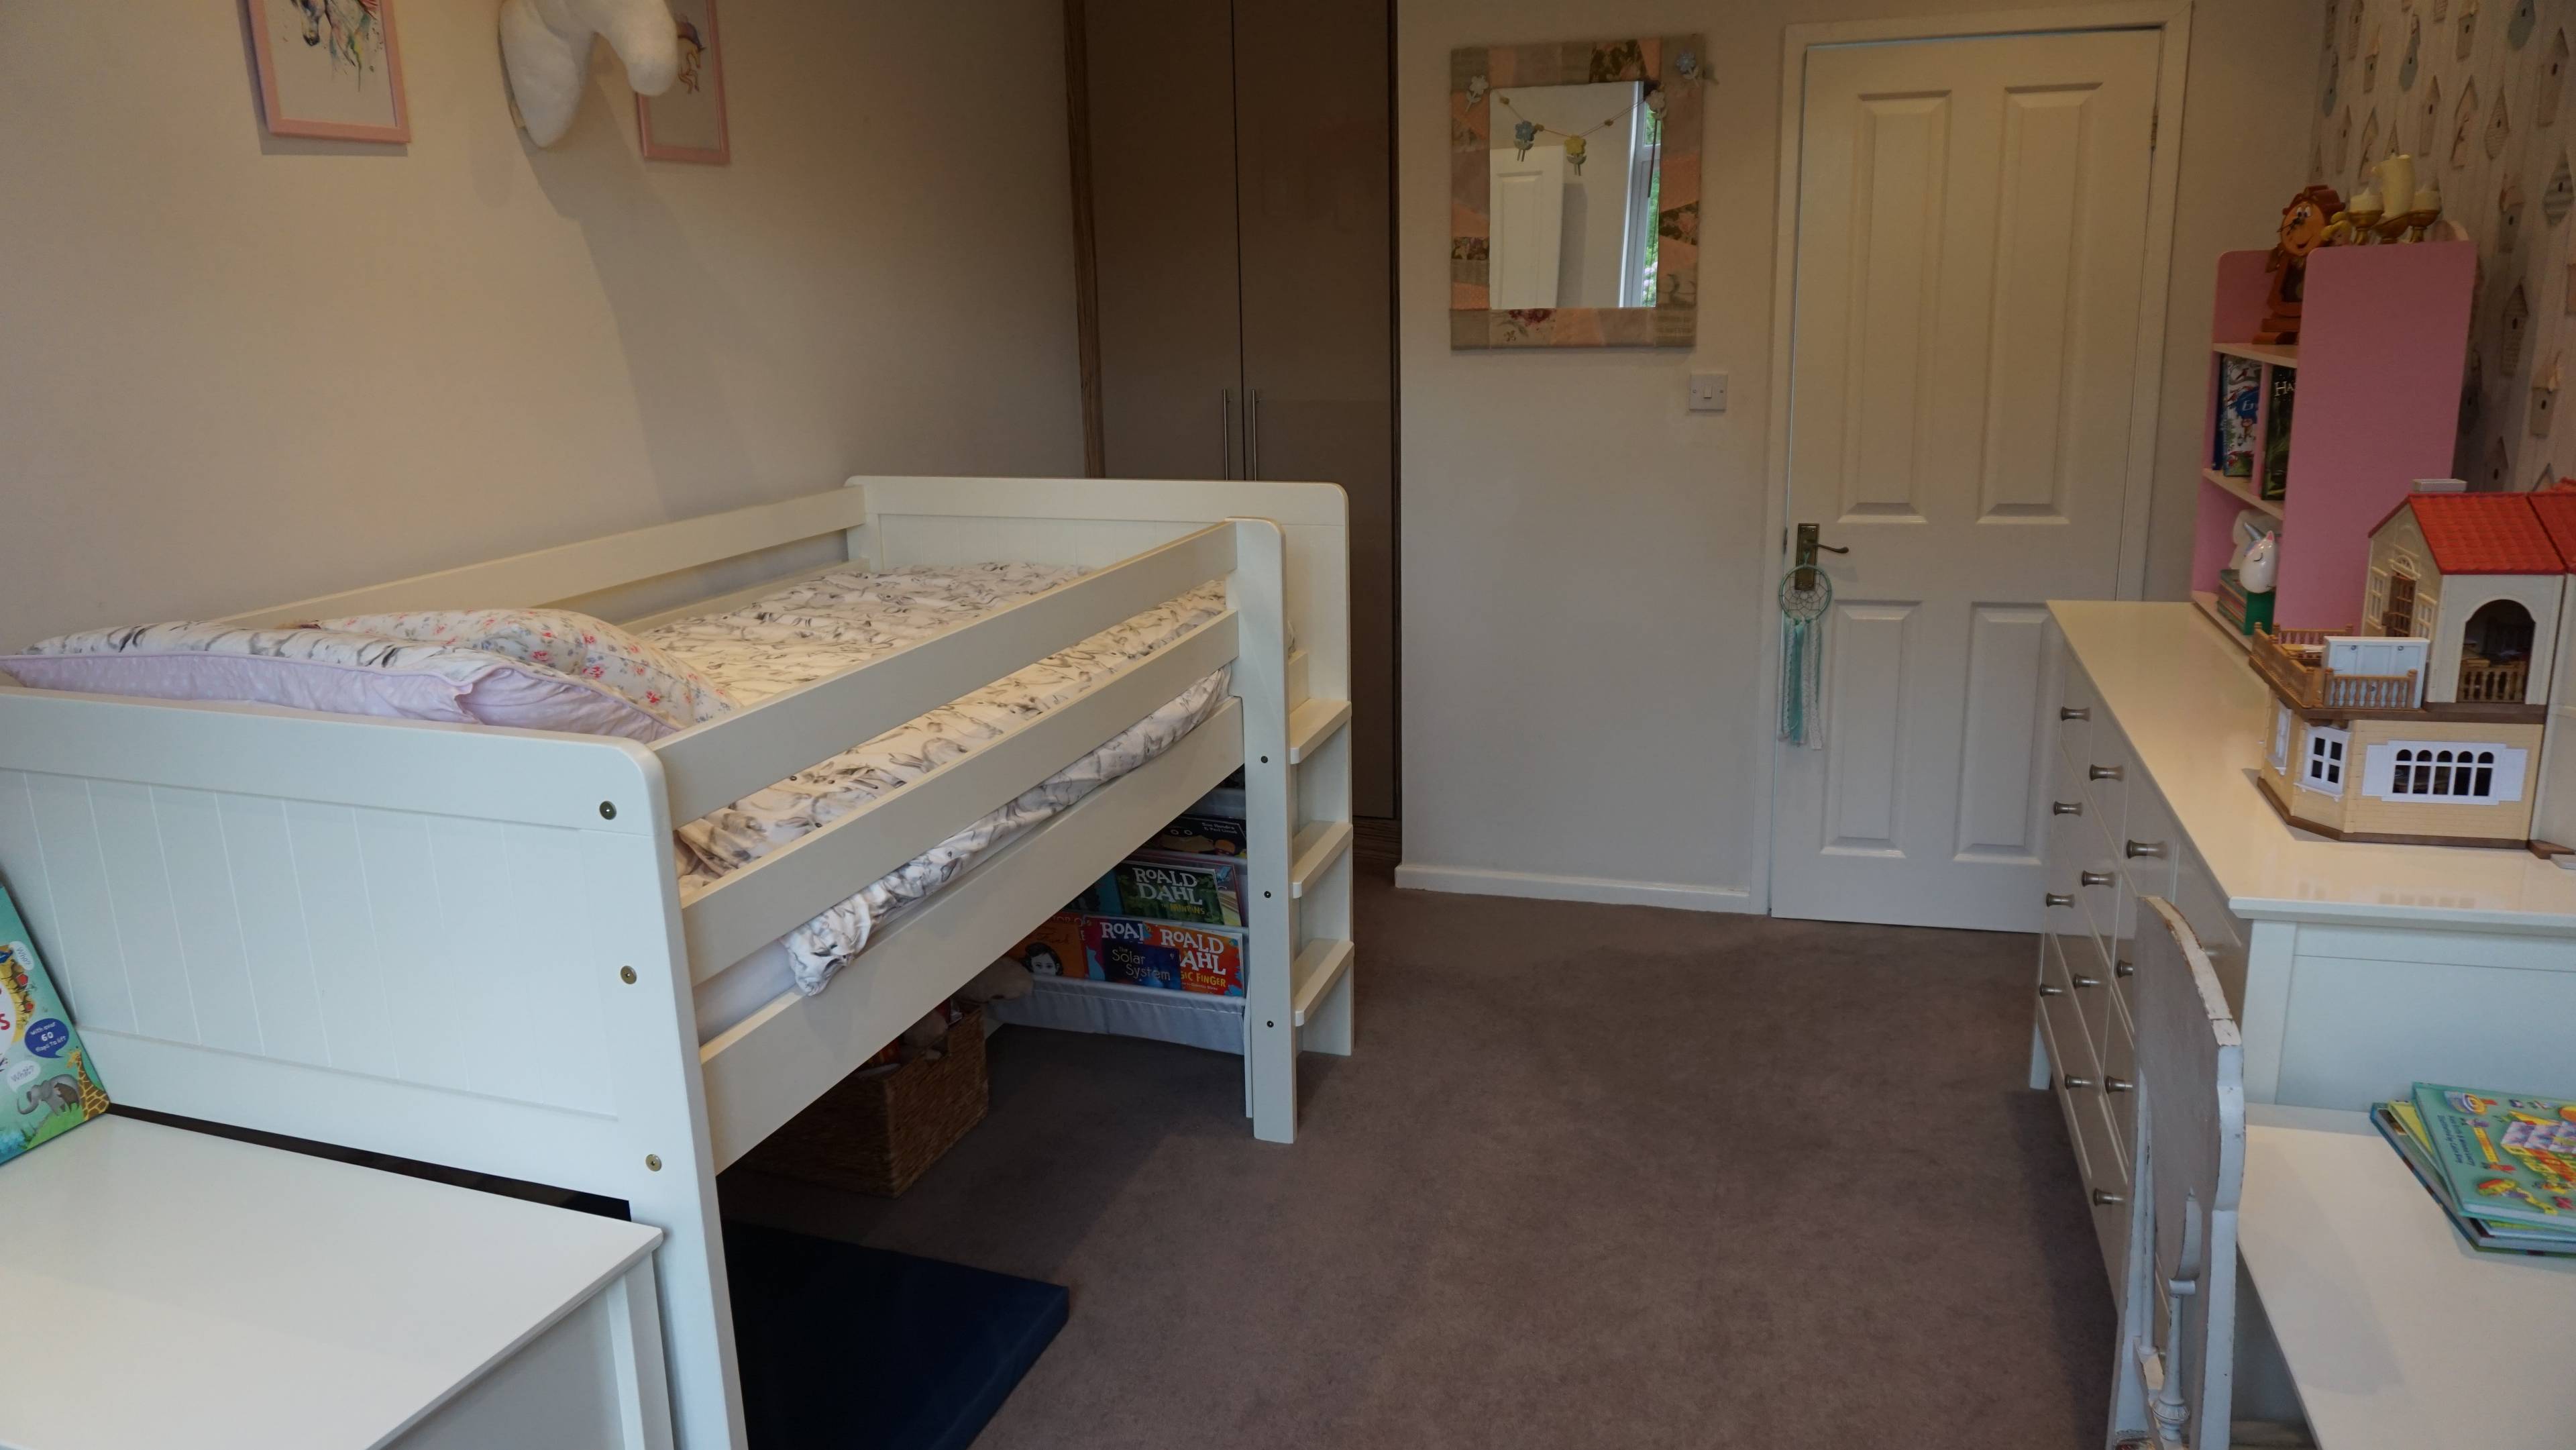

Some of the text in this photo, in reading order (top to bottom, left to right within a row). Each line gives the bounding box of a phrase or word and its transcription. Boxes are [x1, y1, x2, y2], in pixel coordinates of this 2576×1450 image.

[1132, 867, 1197, 887] ROALD
[1136, 882, 1203, 905] DAHL
[1160, 928, 1224, 954] ROALD
[1112, 949, 1146, 965] Solar
[1179, 950, 1226, 976] AHL
[1126, 964, 1171, 981] System
[1196, 973, 1226, 988] FINGER
[41, 1031, 54, 1041] 60
